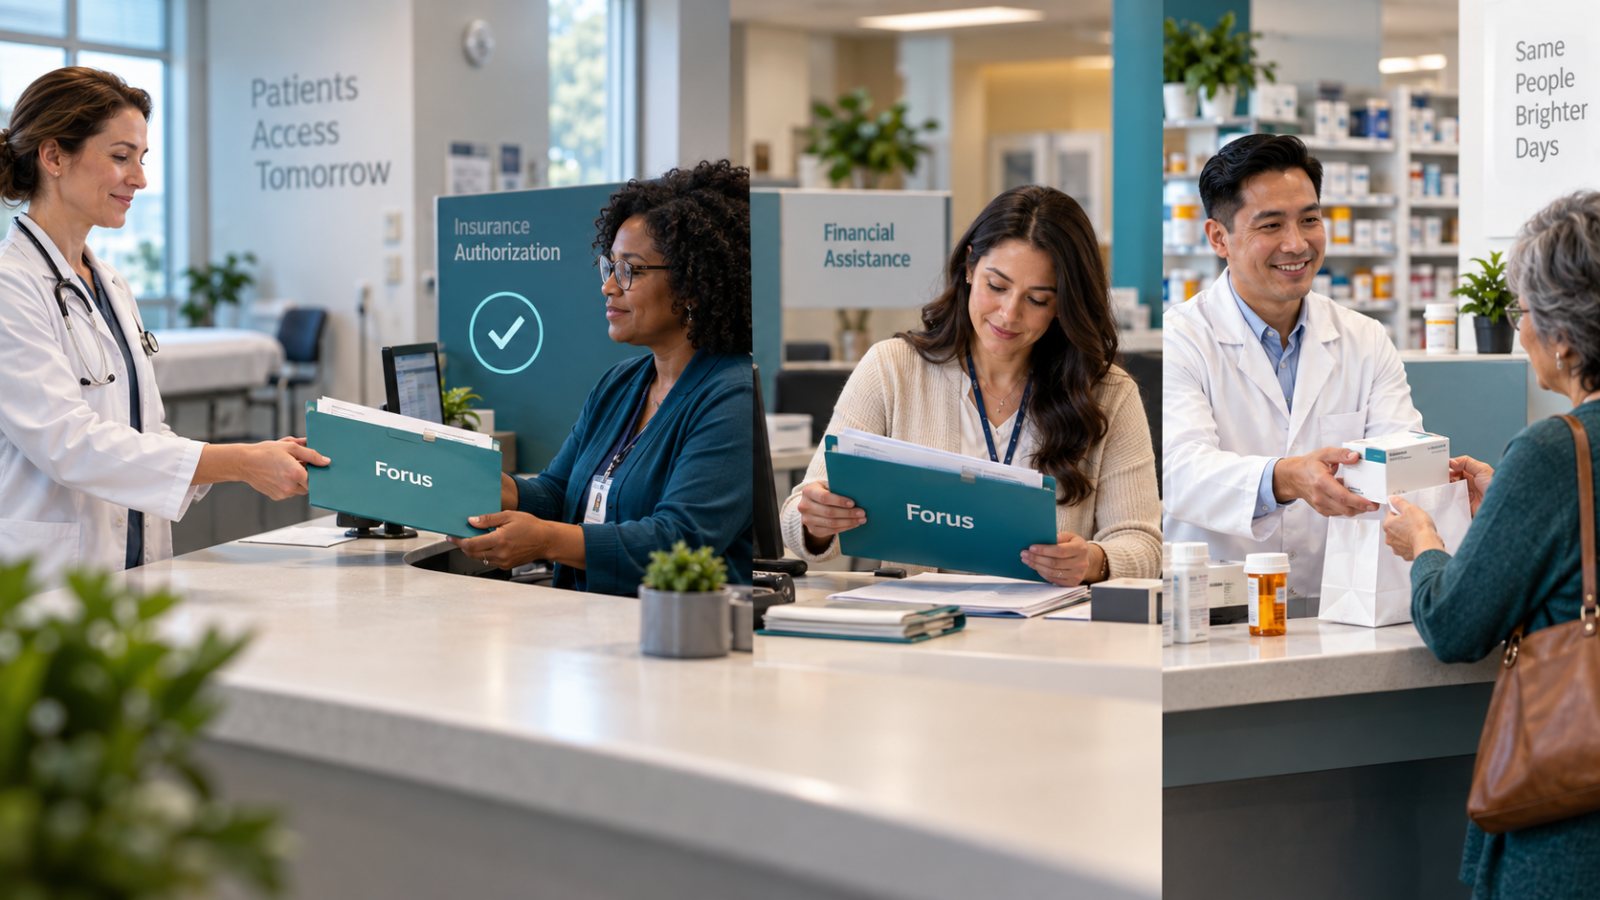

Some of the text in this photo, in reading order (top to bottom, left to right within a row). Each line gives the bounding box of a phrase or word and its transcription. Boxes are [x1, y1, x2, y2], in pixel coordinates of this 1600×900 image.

[1515, 40, 1566, 63] Same
[250, 73, 359, 109] Patients
[1515, 67, 1576, 96] People
[1515, 100, 1589, 130] Brighter
[251, 119, 340, 151] Access
[1515, 137, 1560, 164] Days
[255, 159, 392, 191] Tomorrow
[454, 217, 531, 236] Insurance
[823, 222, 895, 242] Financial
[454, 242, 561, 261] Authorization
[823, 248, 911, 268] Assistance
[375, 460, 433, 488] Forus
[906, 503, 975, 530] Forus
